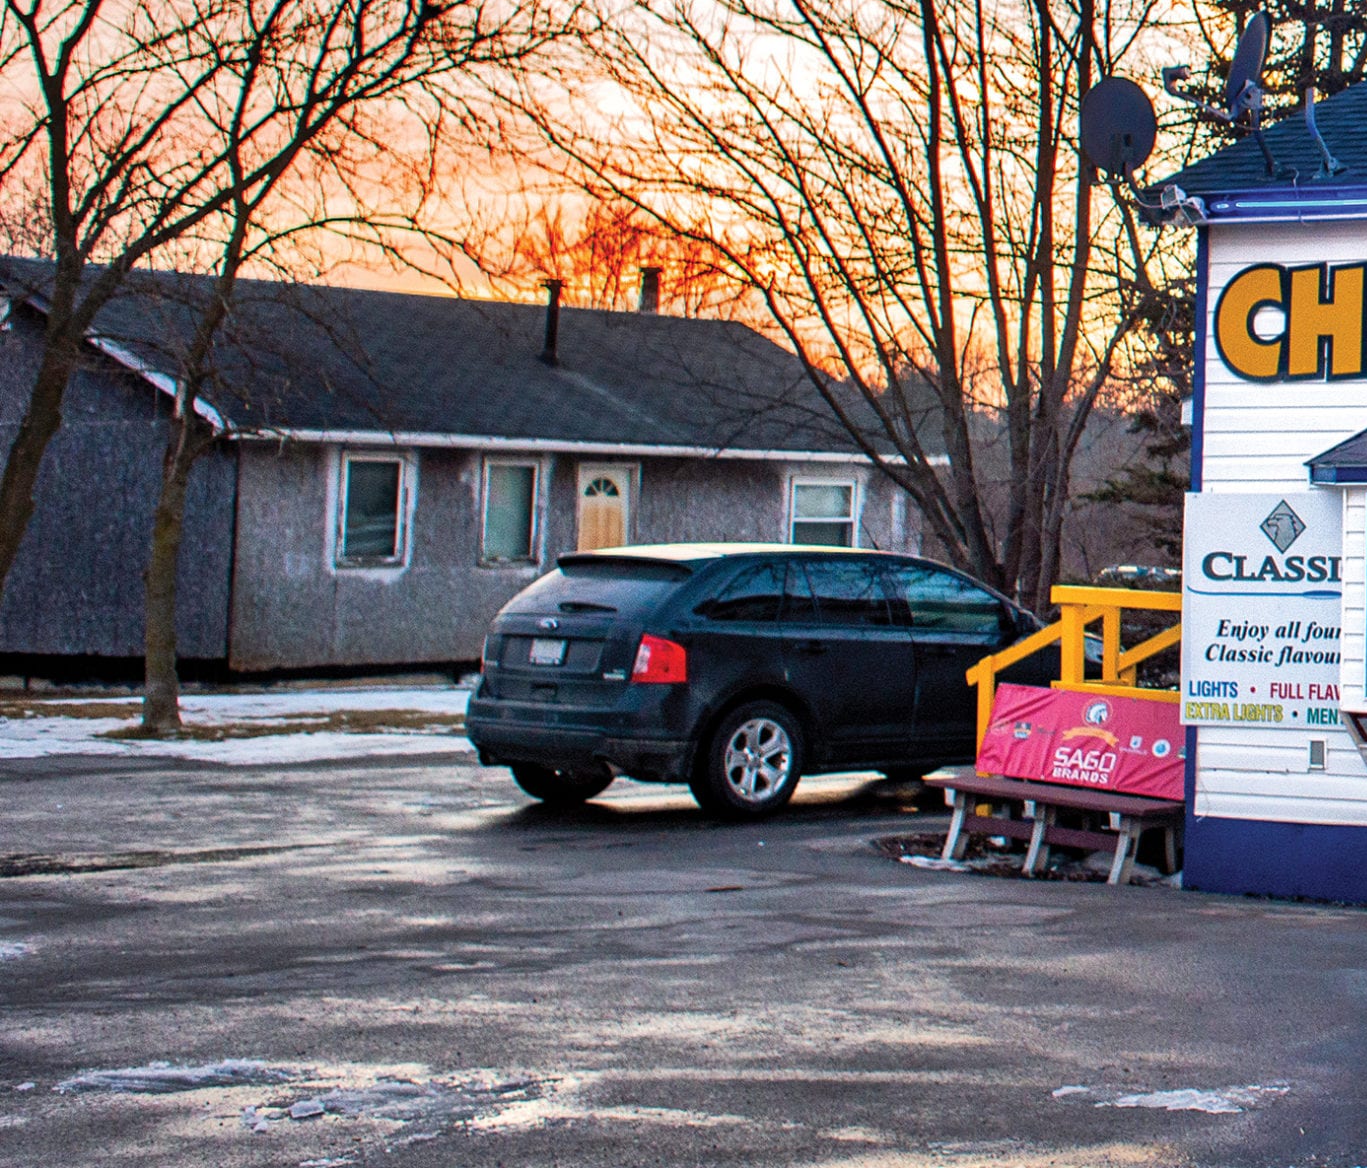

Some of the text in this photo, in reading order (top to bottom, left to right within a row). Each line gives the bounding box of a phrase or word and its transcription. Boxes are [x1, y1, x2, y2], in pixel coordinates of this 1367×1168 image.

[1216, 619, 1269, 641] Enjoy
[1275, 621, 1301, 640] all
[1205, 643, 1273, 663] Classic
[1188, 680, 1239, 698] LIGHTS
[1270, 682, 1304, 700] FULL
[1185, 701, 1342, 725] EXTRA LIGHTS MEN
[1053, 746, 1117, 773] SAGO
[1052, 767, 1109, 783] BRANDS
